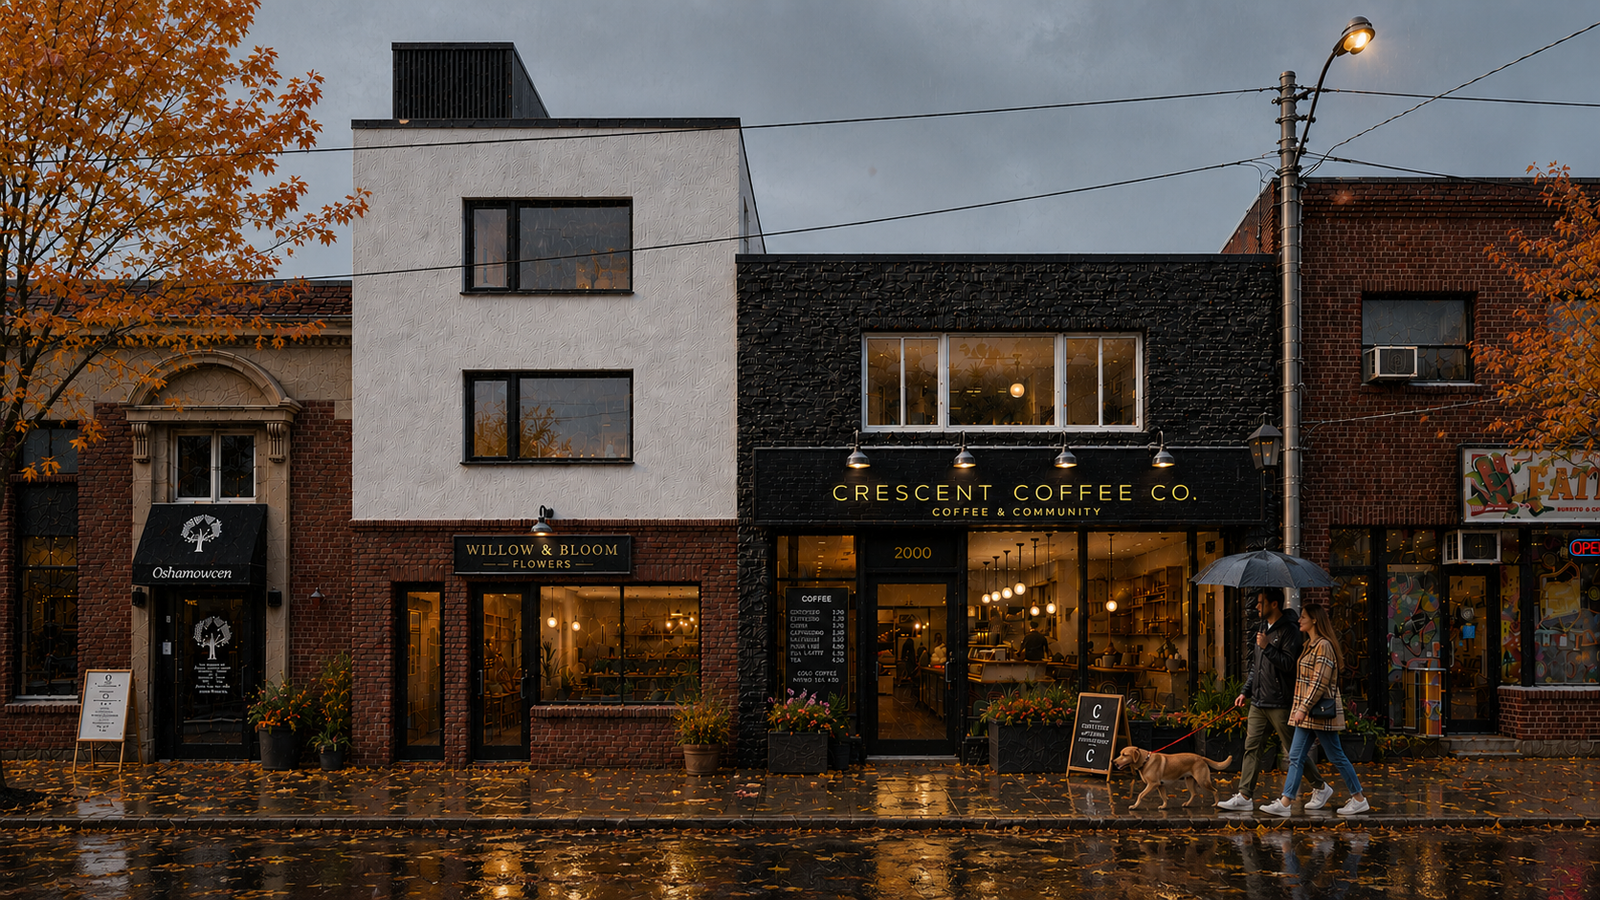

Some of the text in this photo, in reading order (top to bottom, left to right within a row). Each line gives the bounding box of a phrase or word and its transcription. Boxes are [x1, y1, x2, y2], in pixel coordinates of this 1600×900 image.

[832, 484, 1197, 501] CRESCENT COFFEE CO.
[932, 507, 1101, 517] COFFEE & COMMUNITY
[466, 543, 618, 556] WILLOW & BLOOM
[894, 546, 932, 559] 2000
[1571, 541, 1600, 555] OPE
[512, 559, 571, 569] FLOWERS
[801, 595, 832, 603] COFFEE
[1092, 704, 1102, 719] C
[1086, 748, 1095, 763] C
